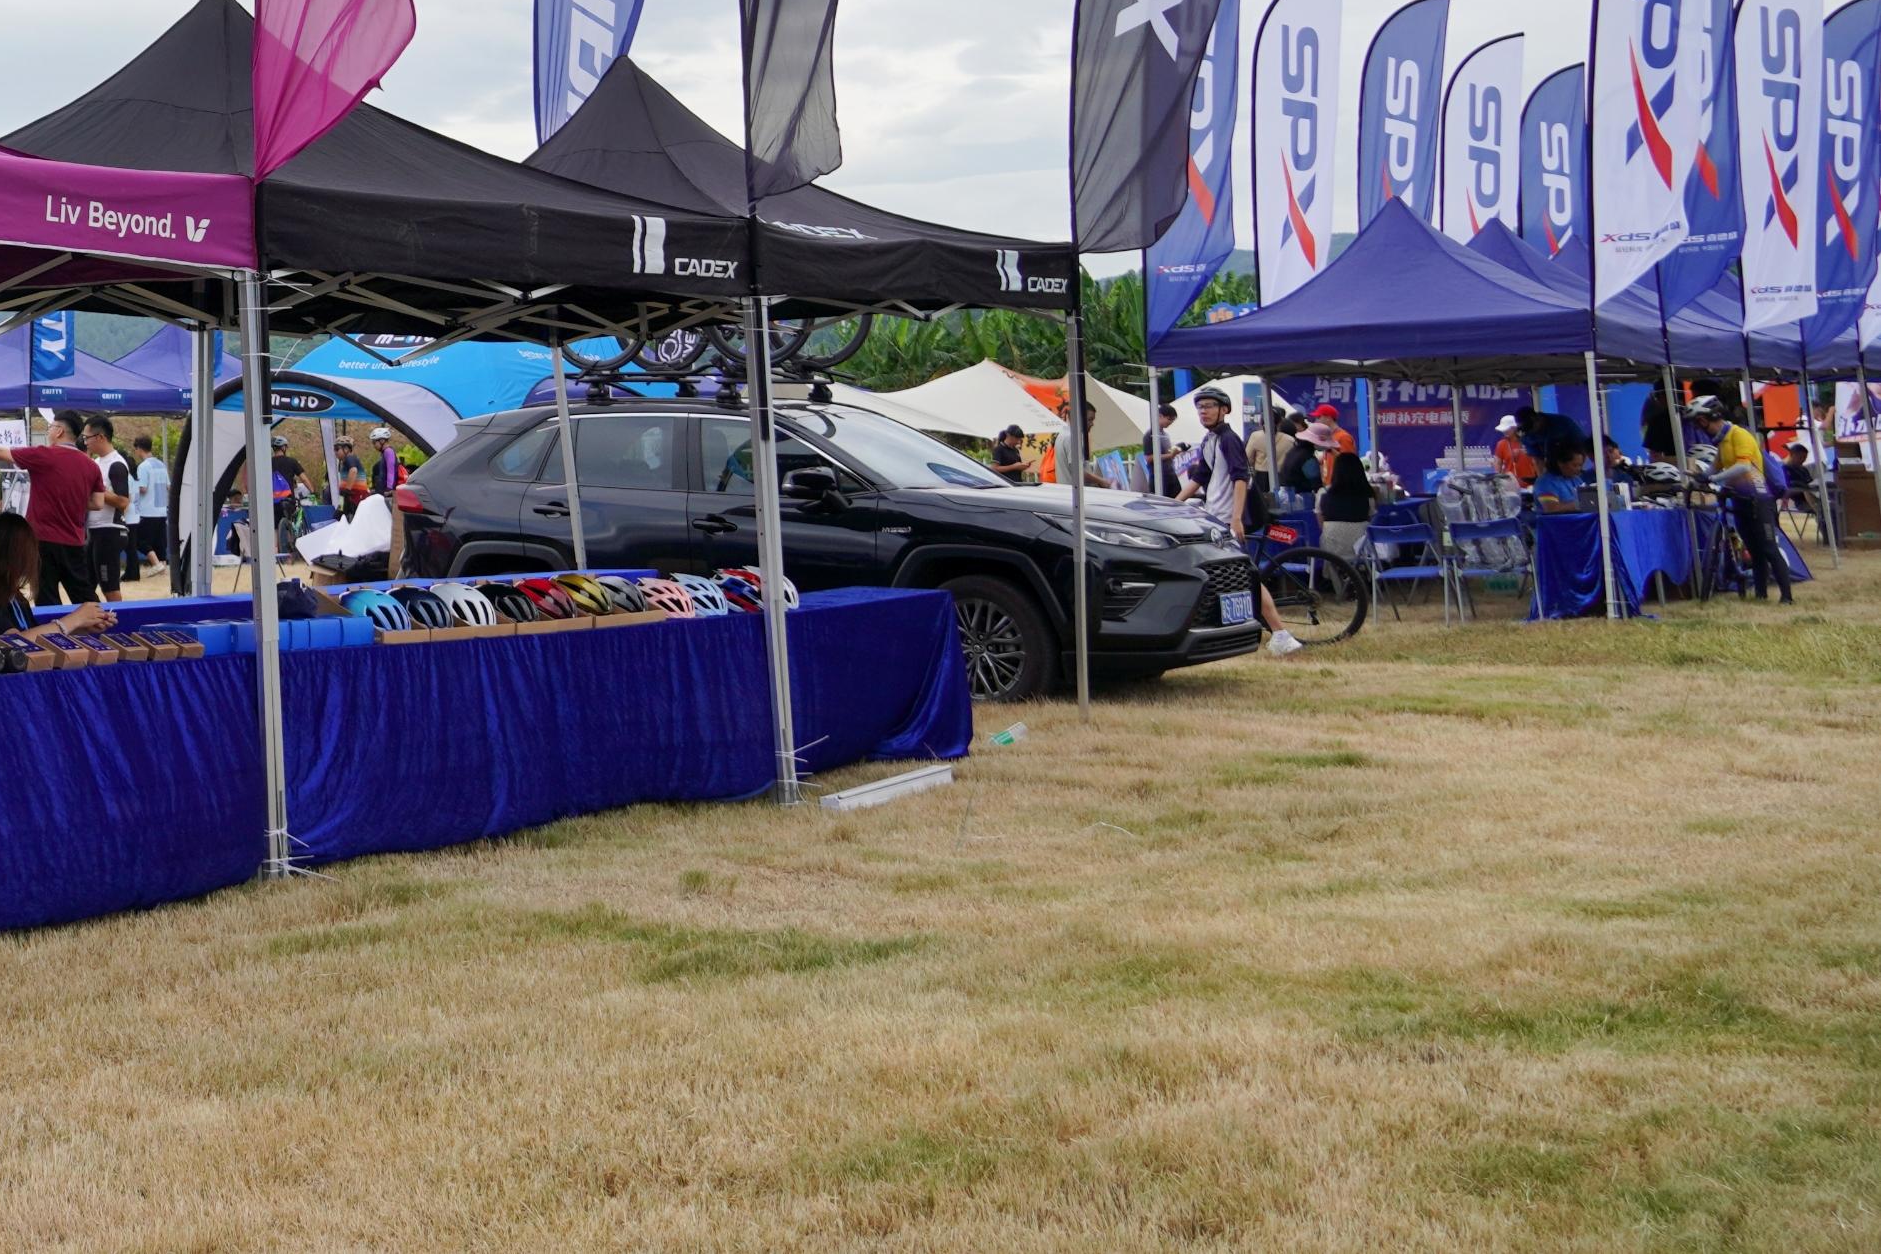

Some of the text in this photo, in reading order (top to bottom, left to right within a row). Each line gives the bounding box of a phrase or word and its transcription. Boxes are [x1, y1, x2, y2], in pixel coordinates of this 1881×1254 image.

[46, 195, 176, 240] Liv Beyond.
[674, 257, 739, 279] CADEX
[1027, 276, 1068, 294] CADEX
[338, 359, 370, 370] better
